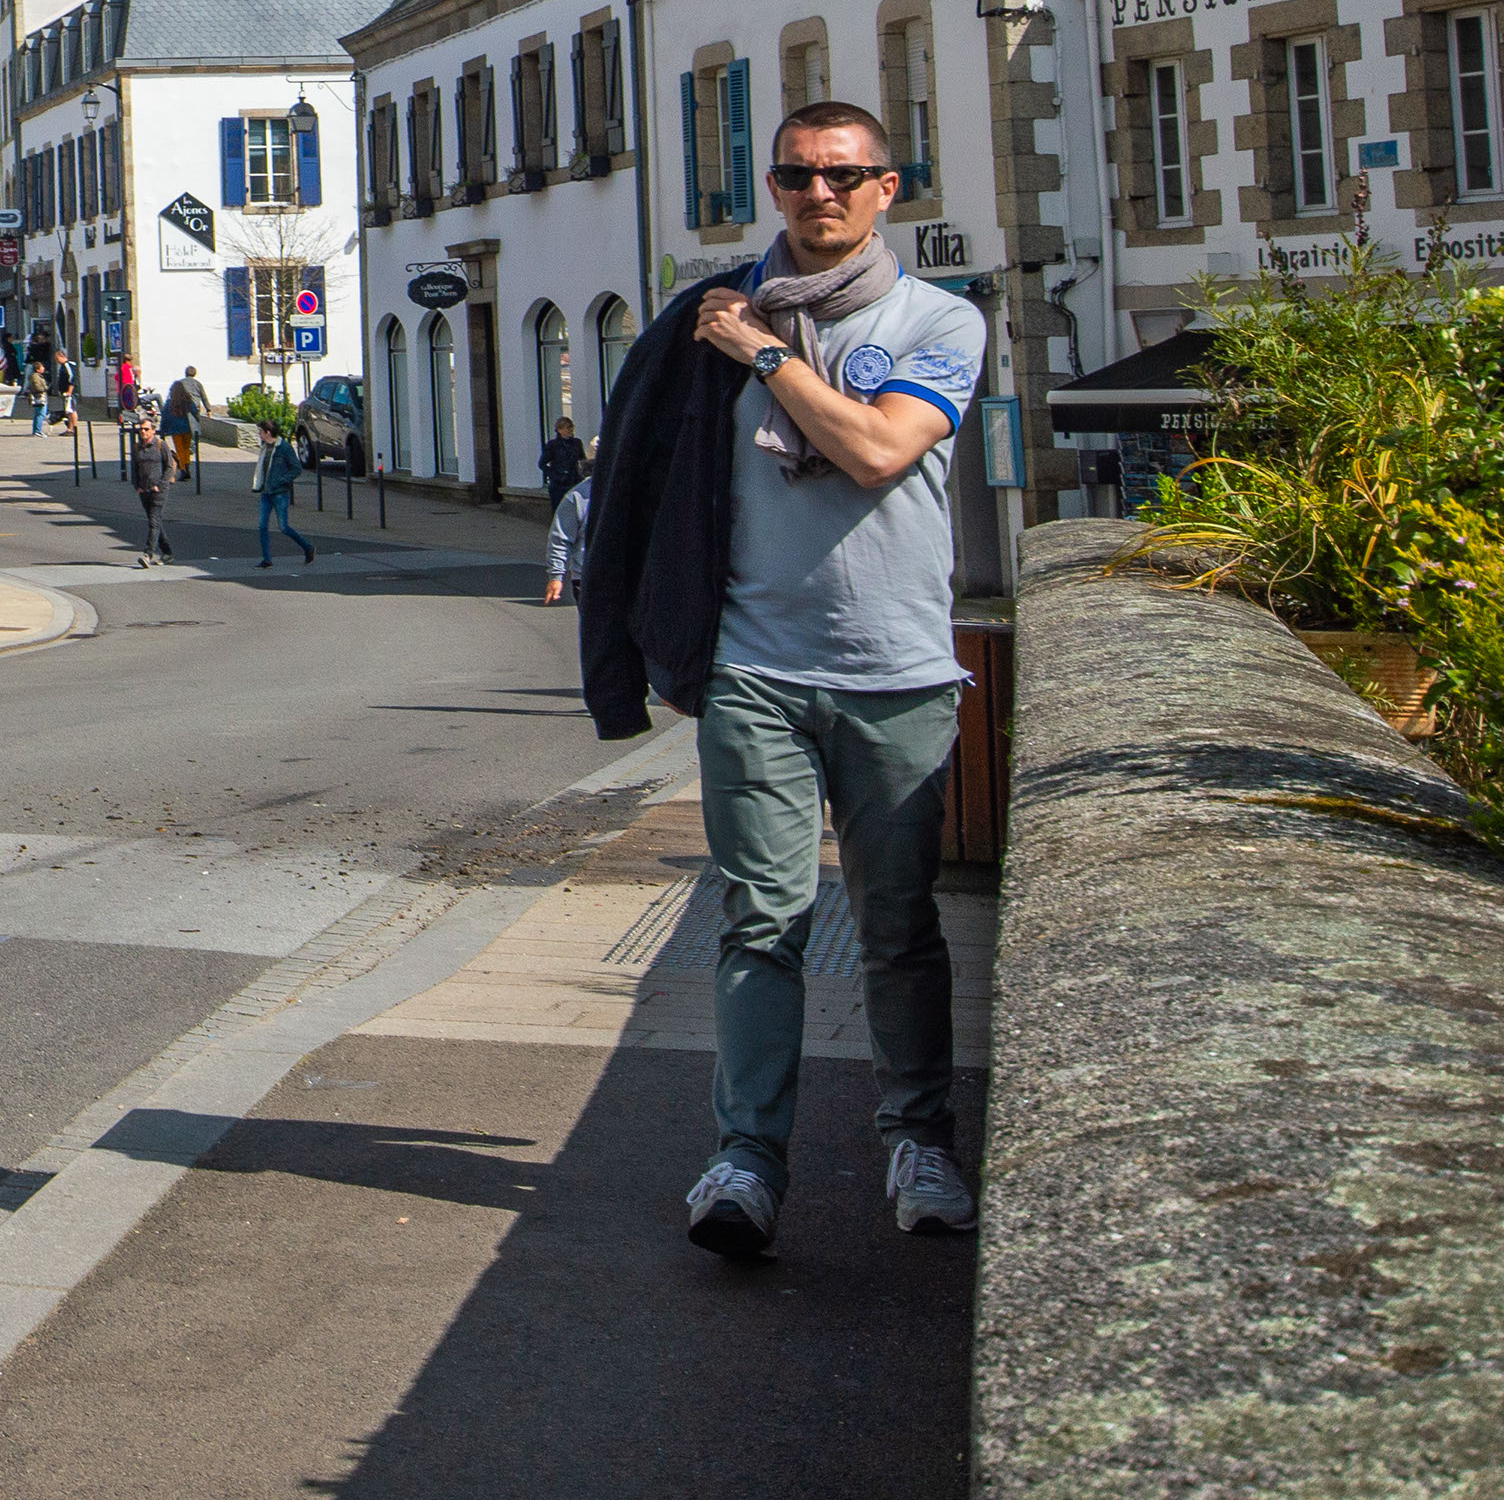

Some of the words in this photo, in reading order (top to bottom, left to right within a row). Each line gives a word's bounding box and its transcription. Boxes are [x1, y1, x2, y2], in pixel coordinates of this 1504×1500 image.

[171, 201, 208, 217] Ajoncs
[915, 222, 966, 269] Kilia
[301, 332, 313, 348] P
[1160, 407, 1230, 429] PENSIO
